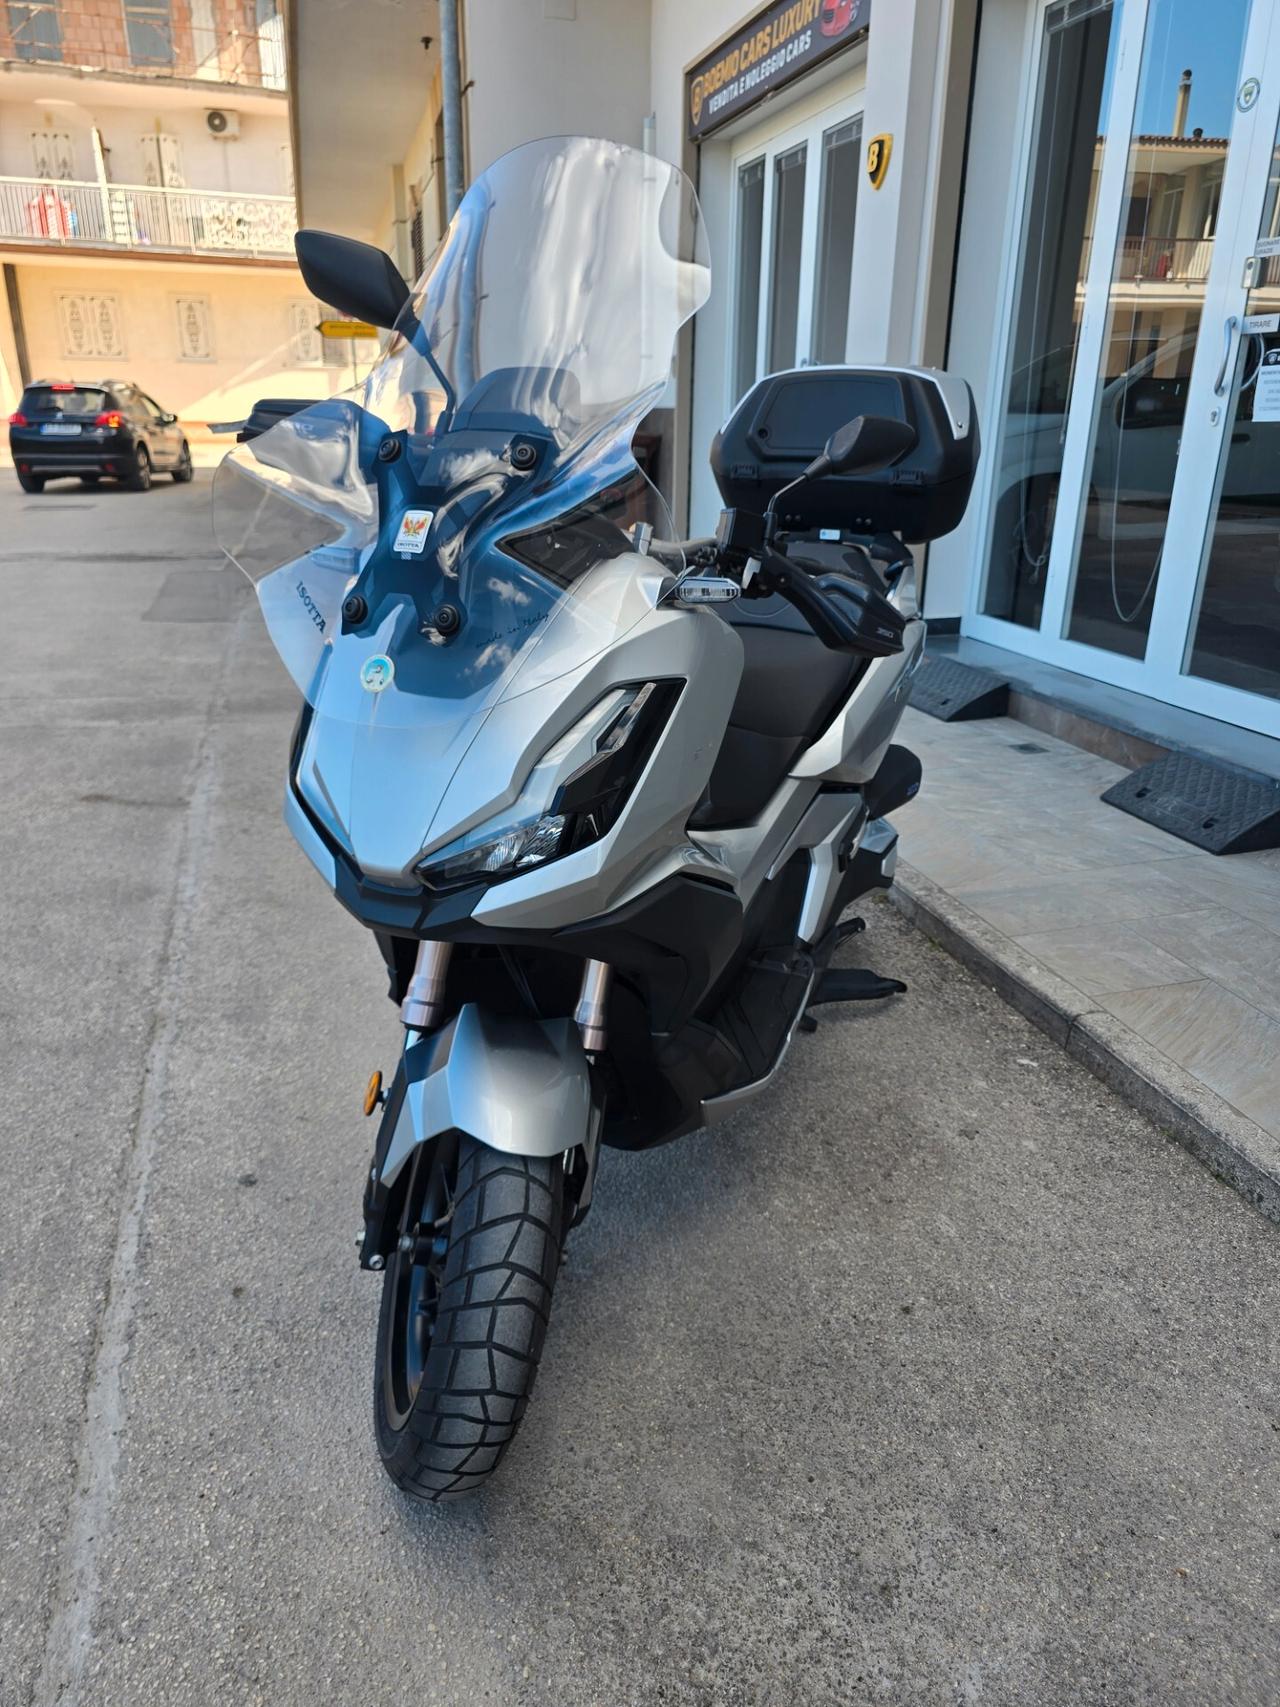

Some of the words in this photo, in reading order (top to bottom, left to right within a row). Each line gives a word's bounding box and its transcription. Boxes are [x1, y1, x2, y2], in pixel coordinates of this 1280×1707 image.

[740, 27, 771, 70] CARS
[772, 0, 821, 48] LUXURY
[709, 81, 739, 114] VENDITA
[739, 76, 746, 94] E
[745, 48, 786, 90] NOLEGGIO
[786, 30, 812, 62] CARS
[1248, 319, 1272, 329] TIRARE
[296, 580, 326, 634] ISOTTA
